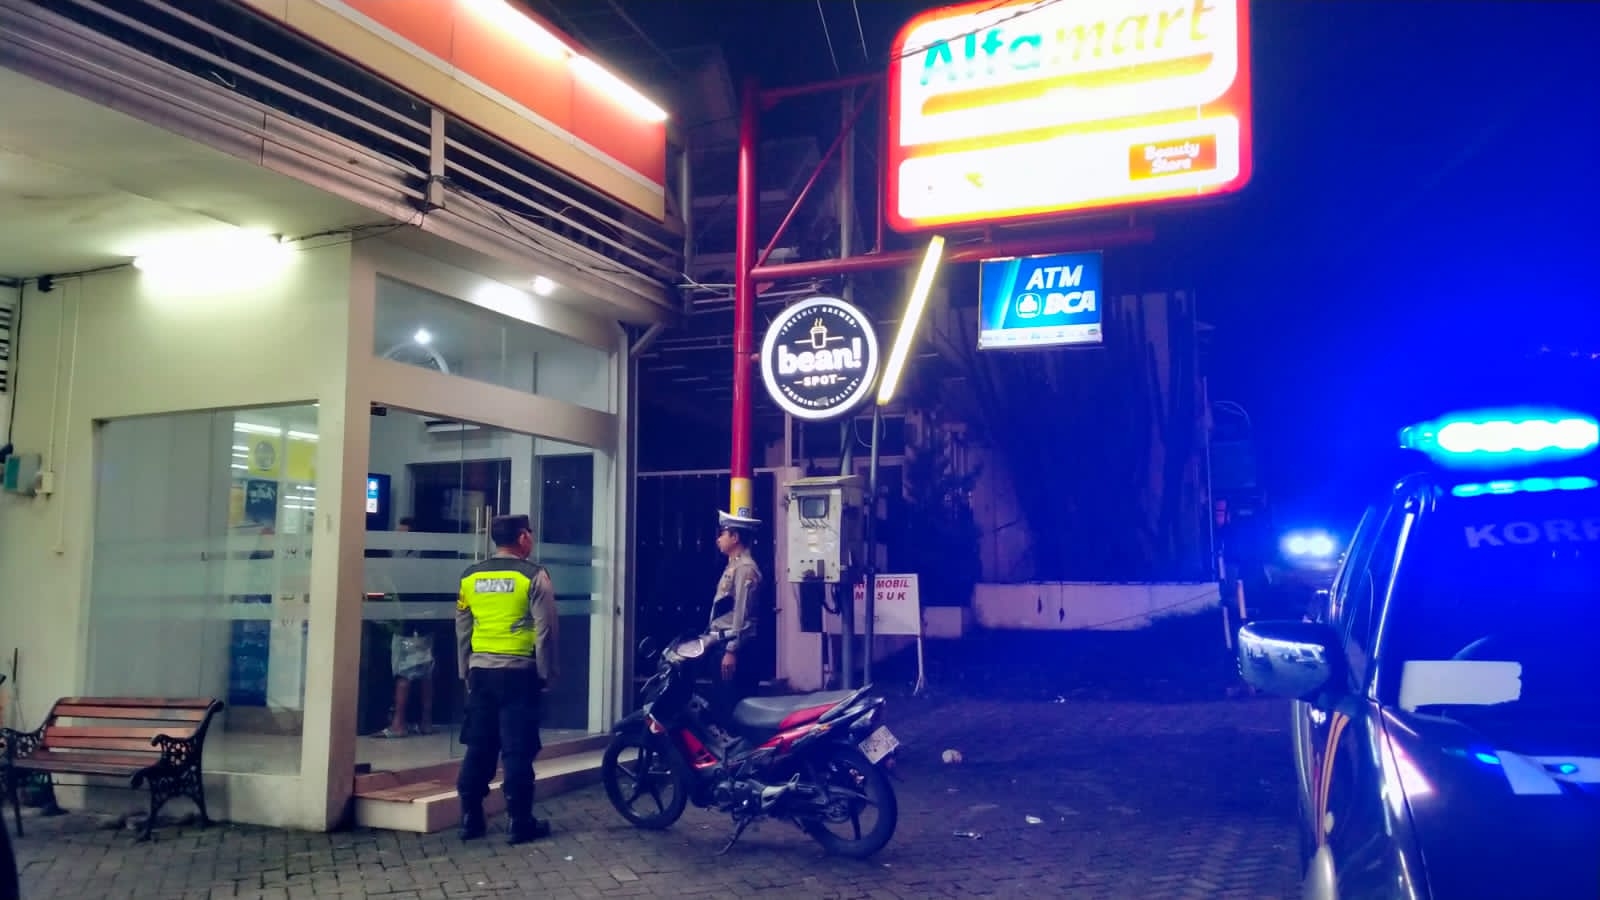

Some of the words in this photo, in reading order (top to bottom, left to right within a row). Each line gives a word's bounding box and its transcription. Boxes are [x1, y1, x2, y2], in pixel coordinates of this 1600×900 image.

[919, 0, 1216, 86] Alfamart
[1143, 142, 1200, 160] Beauty
[1025, 264, 1083, 290] ATM
[1043, 290, 1096, 315] BCA
[777, 337, 862, 375] bean!
[803, 374, 838, 387] SPOT
[824, 381, 857, 407] UALITY
[855, 591, 906, 601] MSUK
[876, 579, 910, 589] MOBIL
